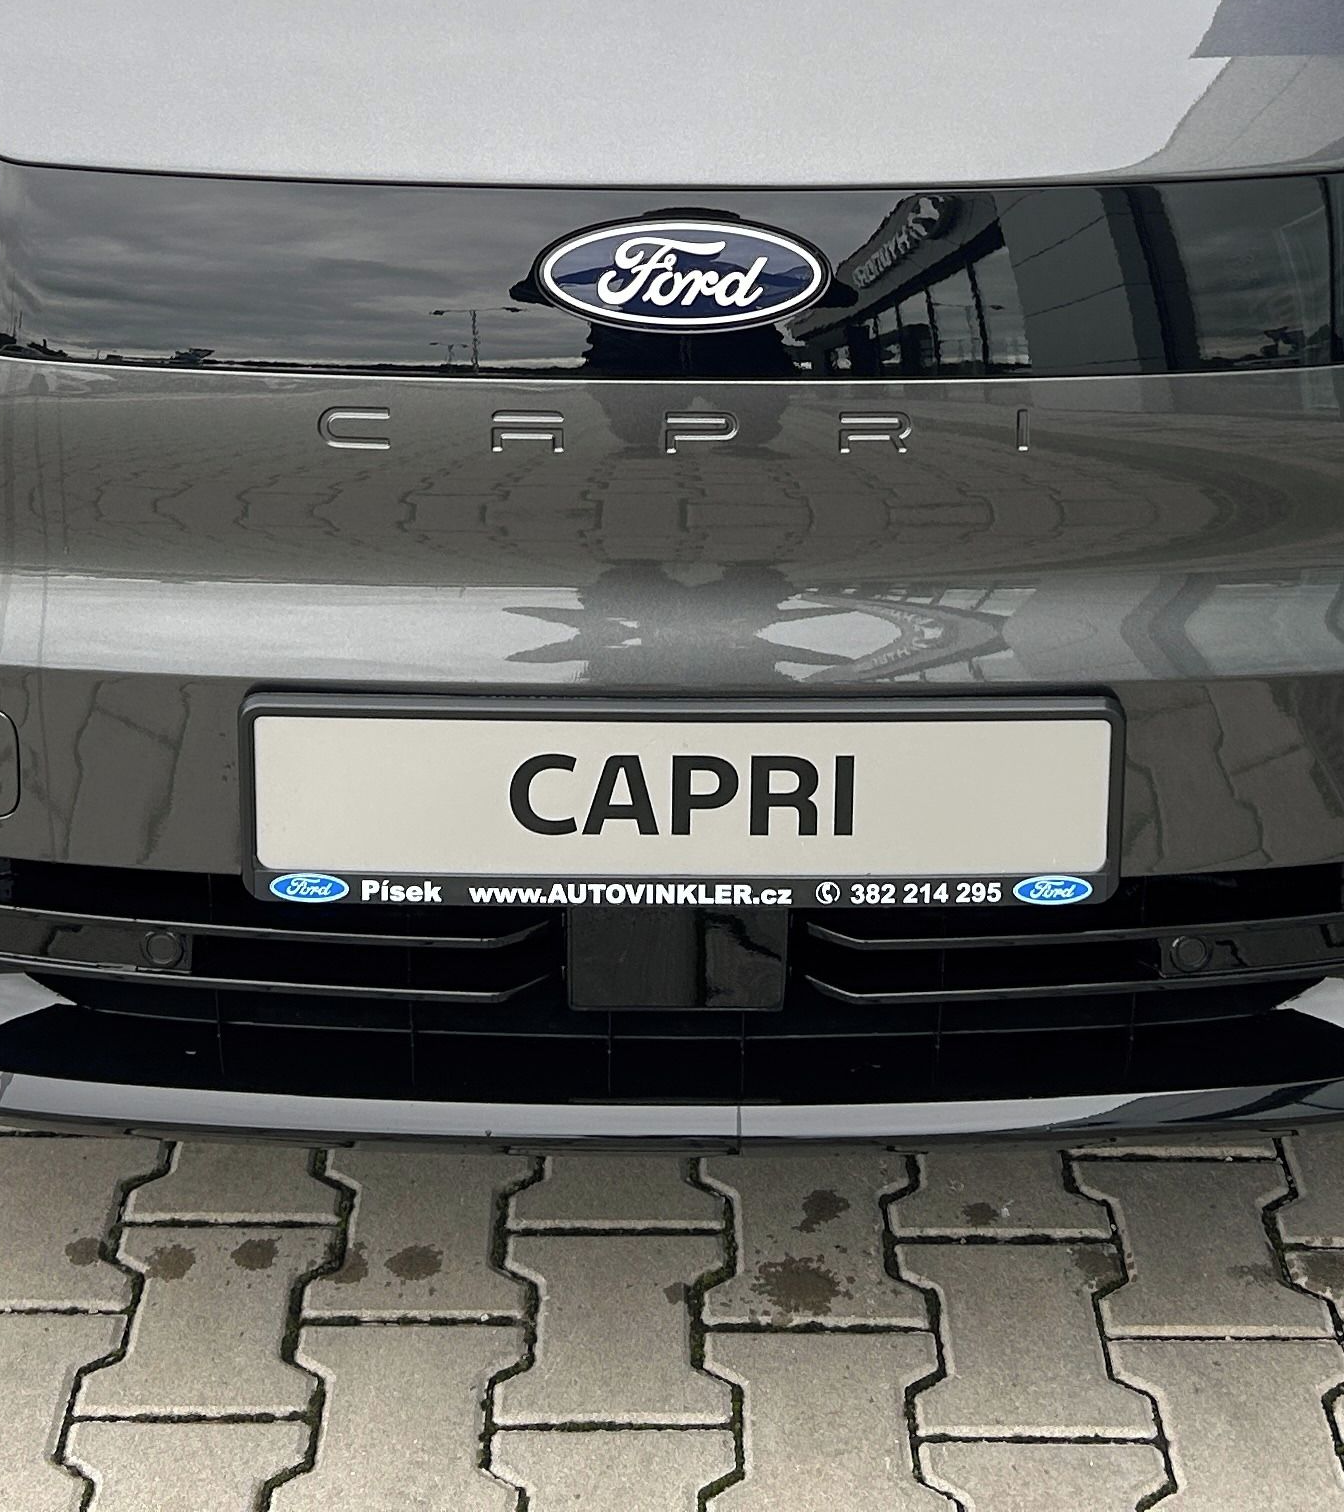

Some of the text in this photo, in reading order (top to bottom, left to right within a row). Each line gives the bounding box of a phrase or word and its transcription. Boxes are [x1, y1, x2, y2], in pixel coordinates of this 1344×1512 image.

[597, 236, 768, 307] Ford
[316, 404, 1032, 455] CAPRI
[509, 752, 855, 836] CAPRI
[361, 879, 443, 904] Písek
[468, 882, 793, 906] www.AUTOVINKLER.cz
[850, 883, 896, 905] 382
[902, 883, 949, 904] 214
[955, 882, 1002, 904] 295
